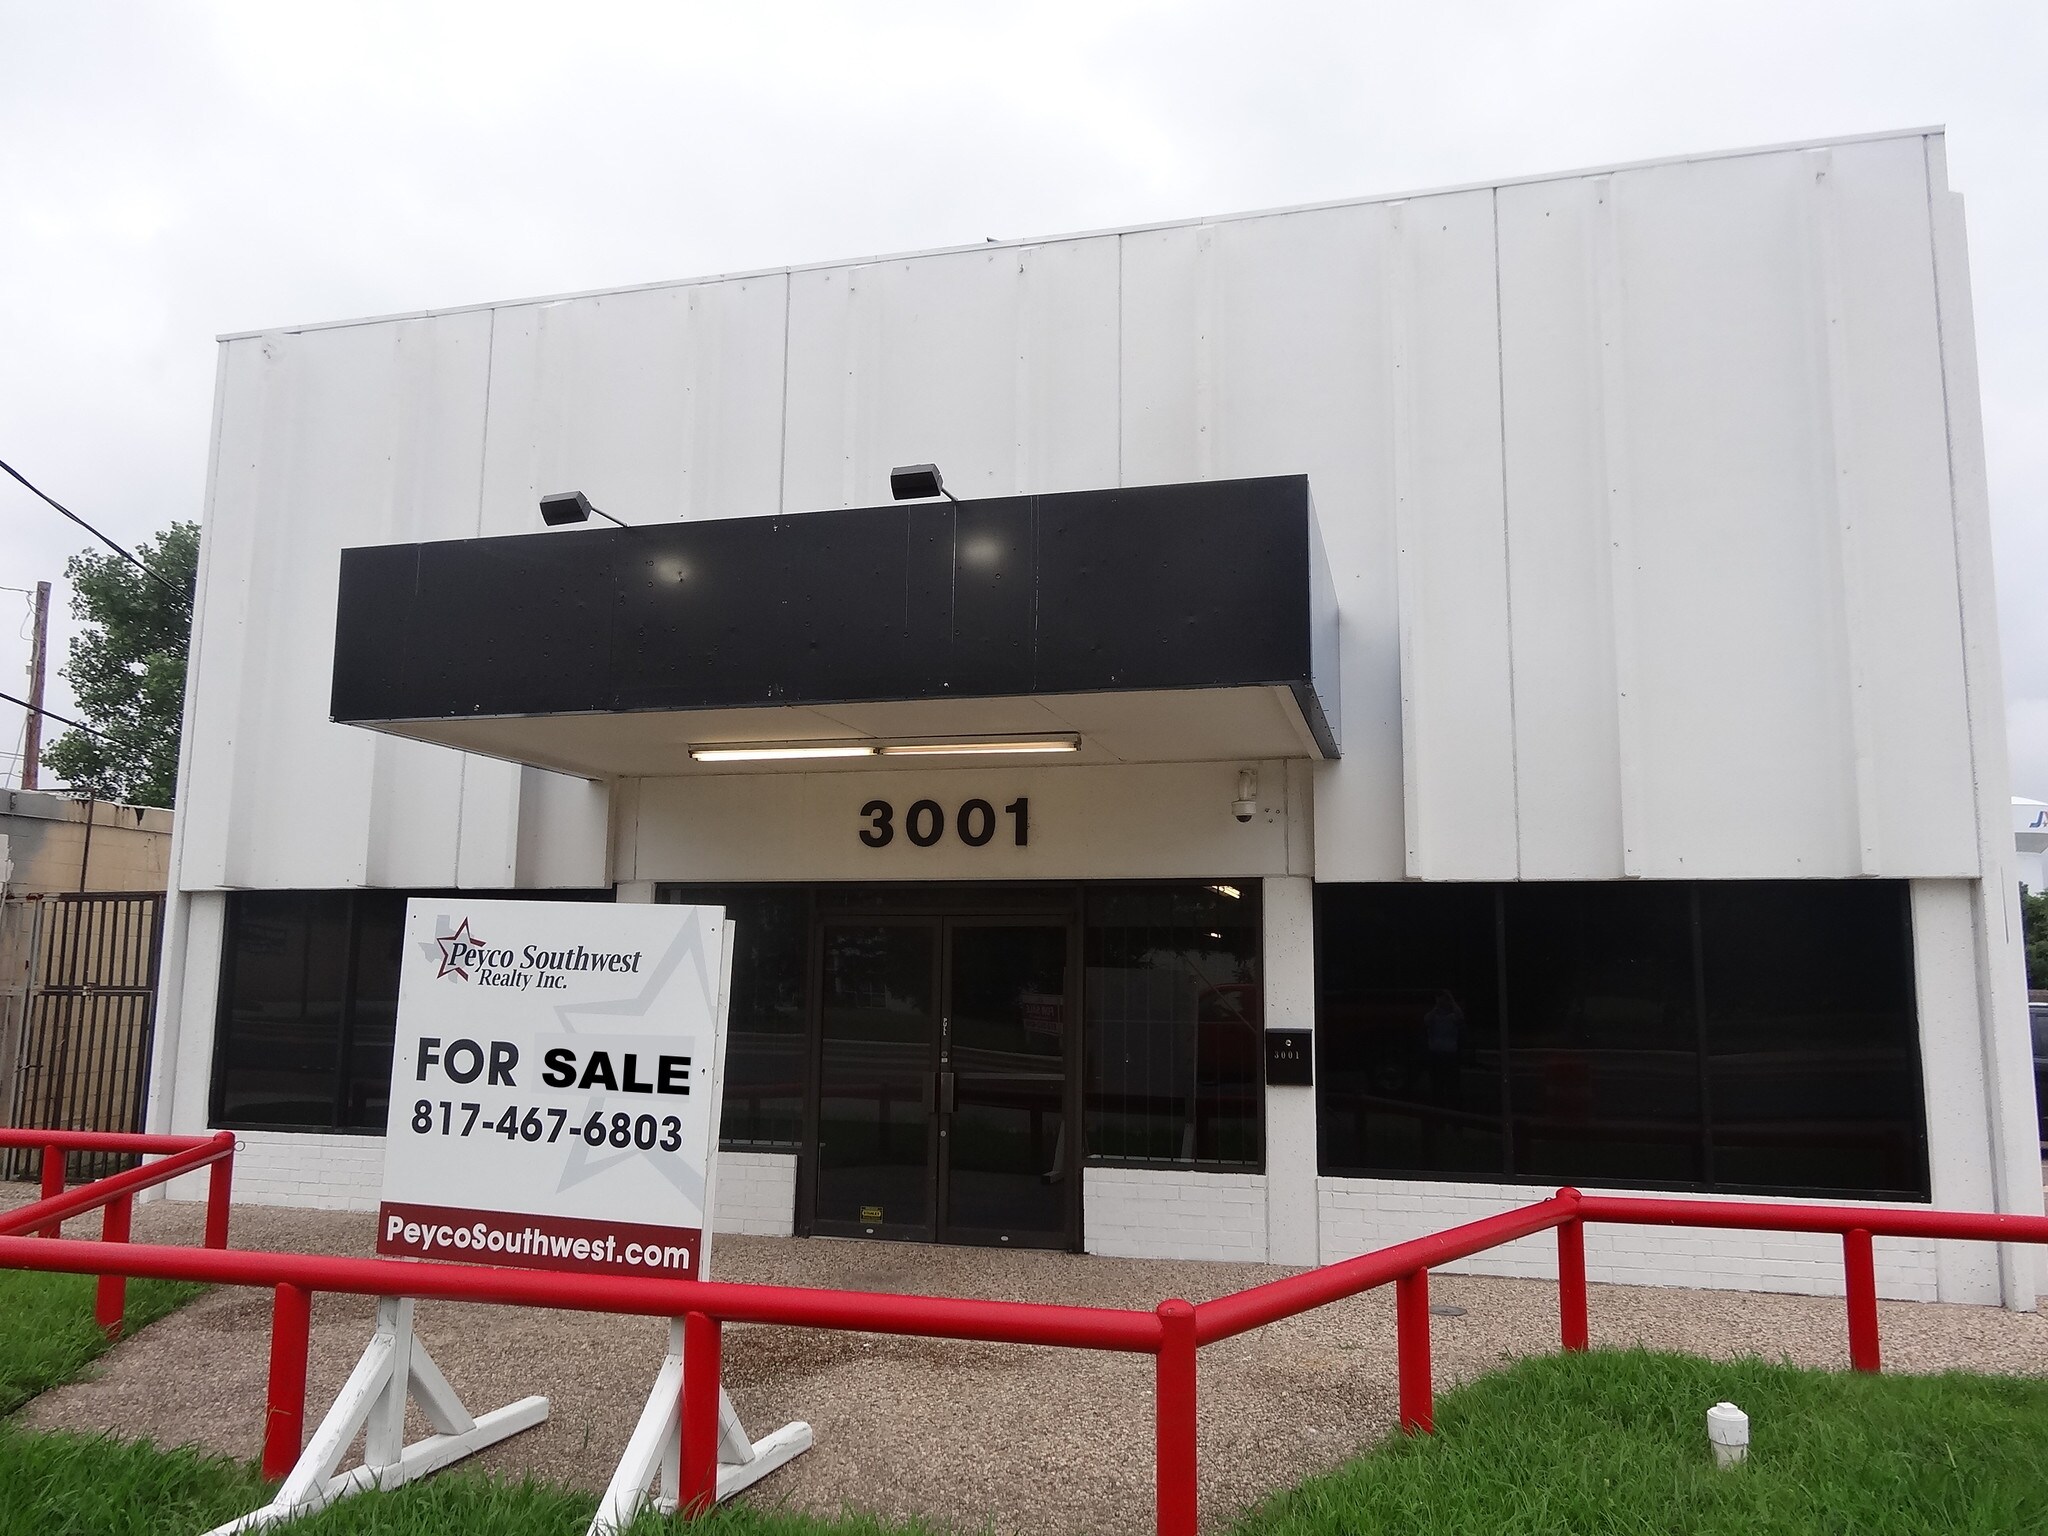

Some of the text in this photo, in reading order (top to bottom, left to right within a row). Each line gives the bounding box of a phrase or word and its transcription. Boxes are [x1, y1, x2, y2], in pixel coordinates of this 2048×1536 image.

[859, 797, 1029, 847] 3001
[447, 942, 643, 973] Peyco Southwest
[477, 968, 568, 991] Realty Inc.
[415, 1037, 692, 1096] FOR SALE
[1274, 1050, 1299, 1060] 3001
[411, 1099, 683, 1152] 817-467-6803
[386, 1215, 690, 1270] PeycoSouthwest.com
